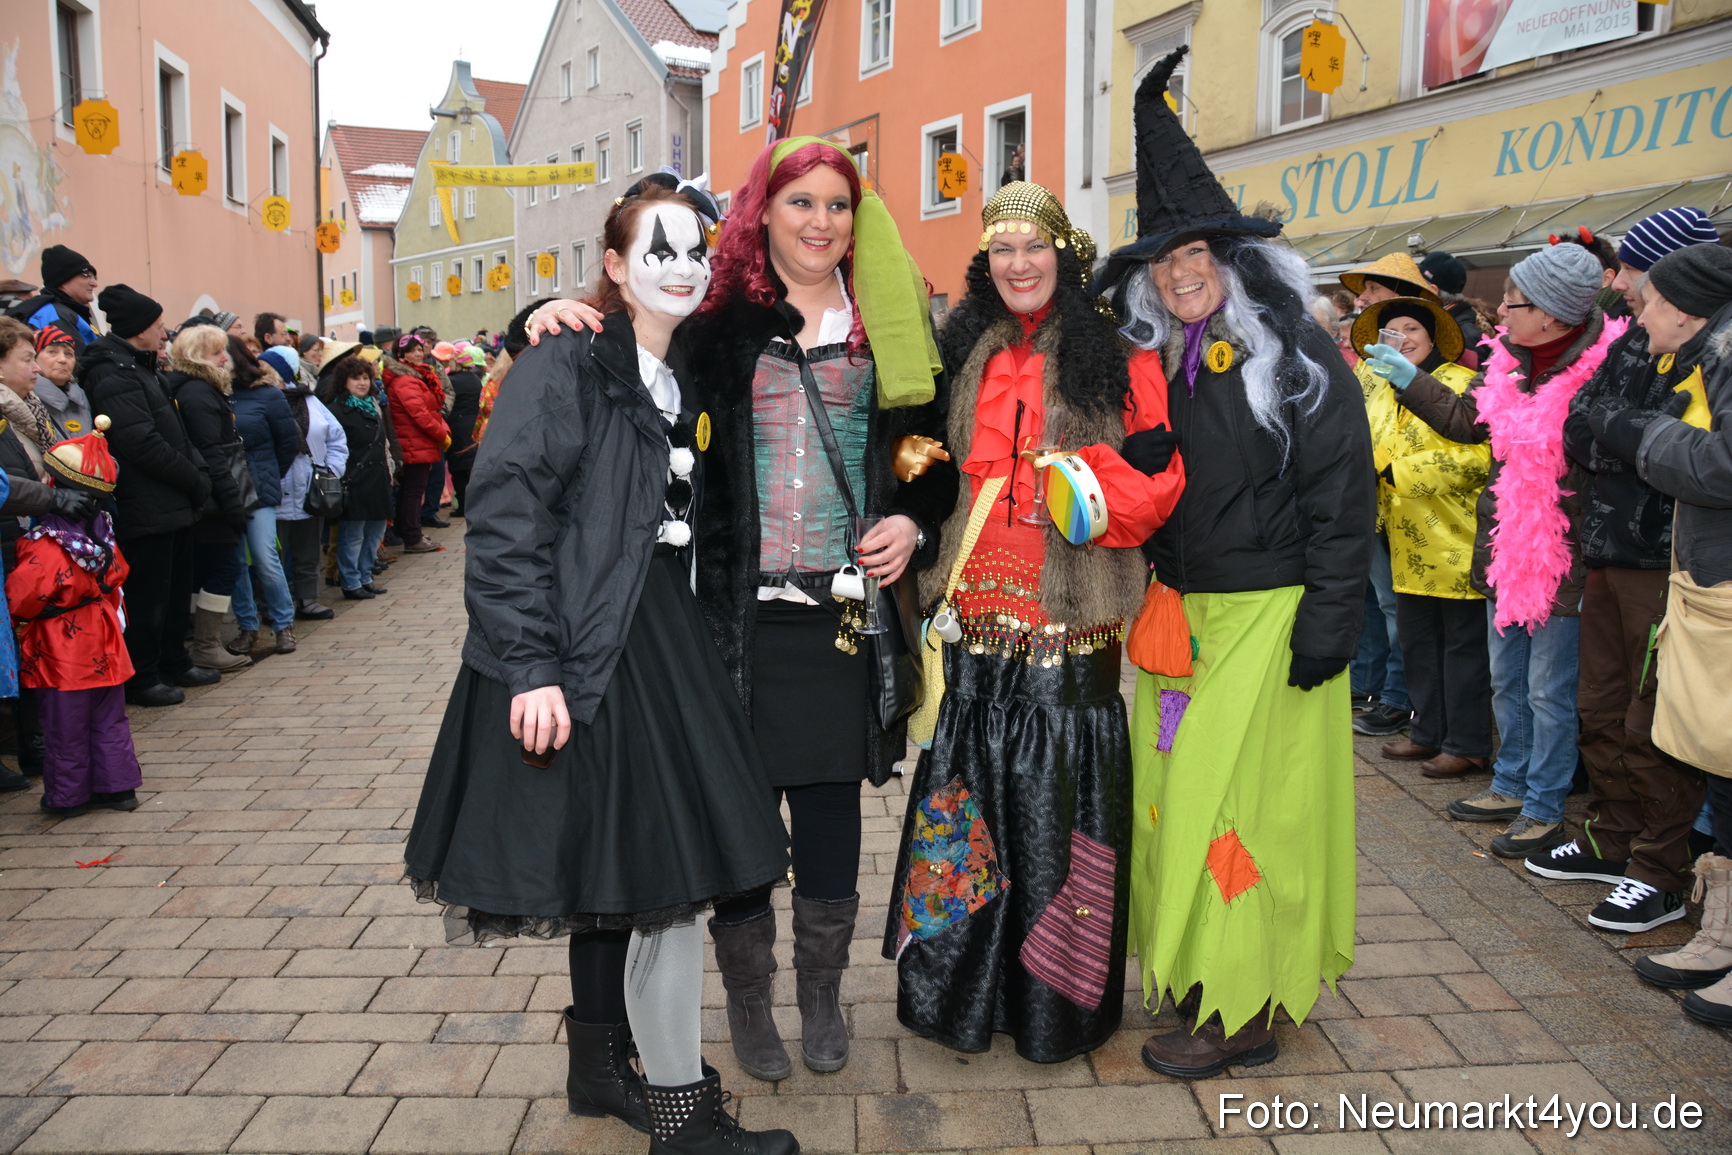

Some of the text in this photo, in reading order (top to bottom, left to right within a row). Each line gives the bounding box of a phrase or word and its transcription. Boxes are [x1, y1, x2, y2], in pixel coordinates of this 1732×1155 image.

[1564, 11, 1631, 39] MAI 2015
[1278, 137, 1439, 225] STOLL
